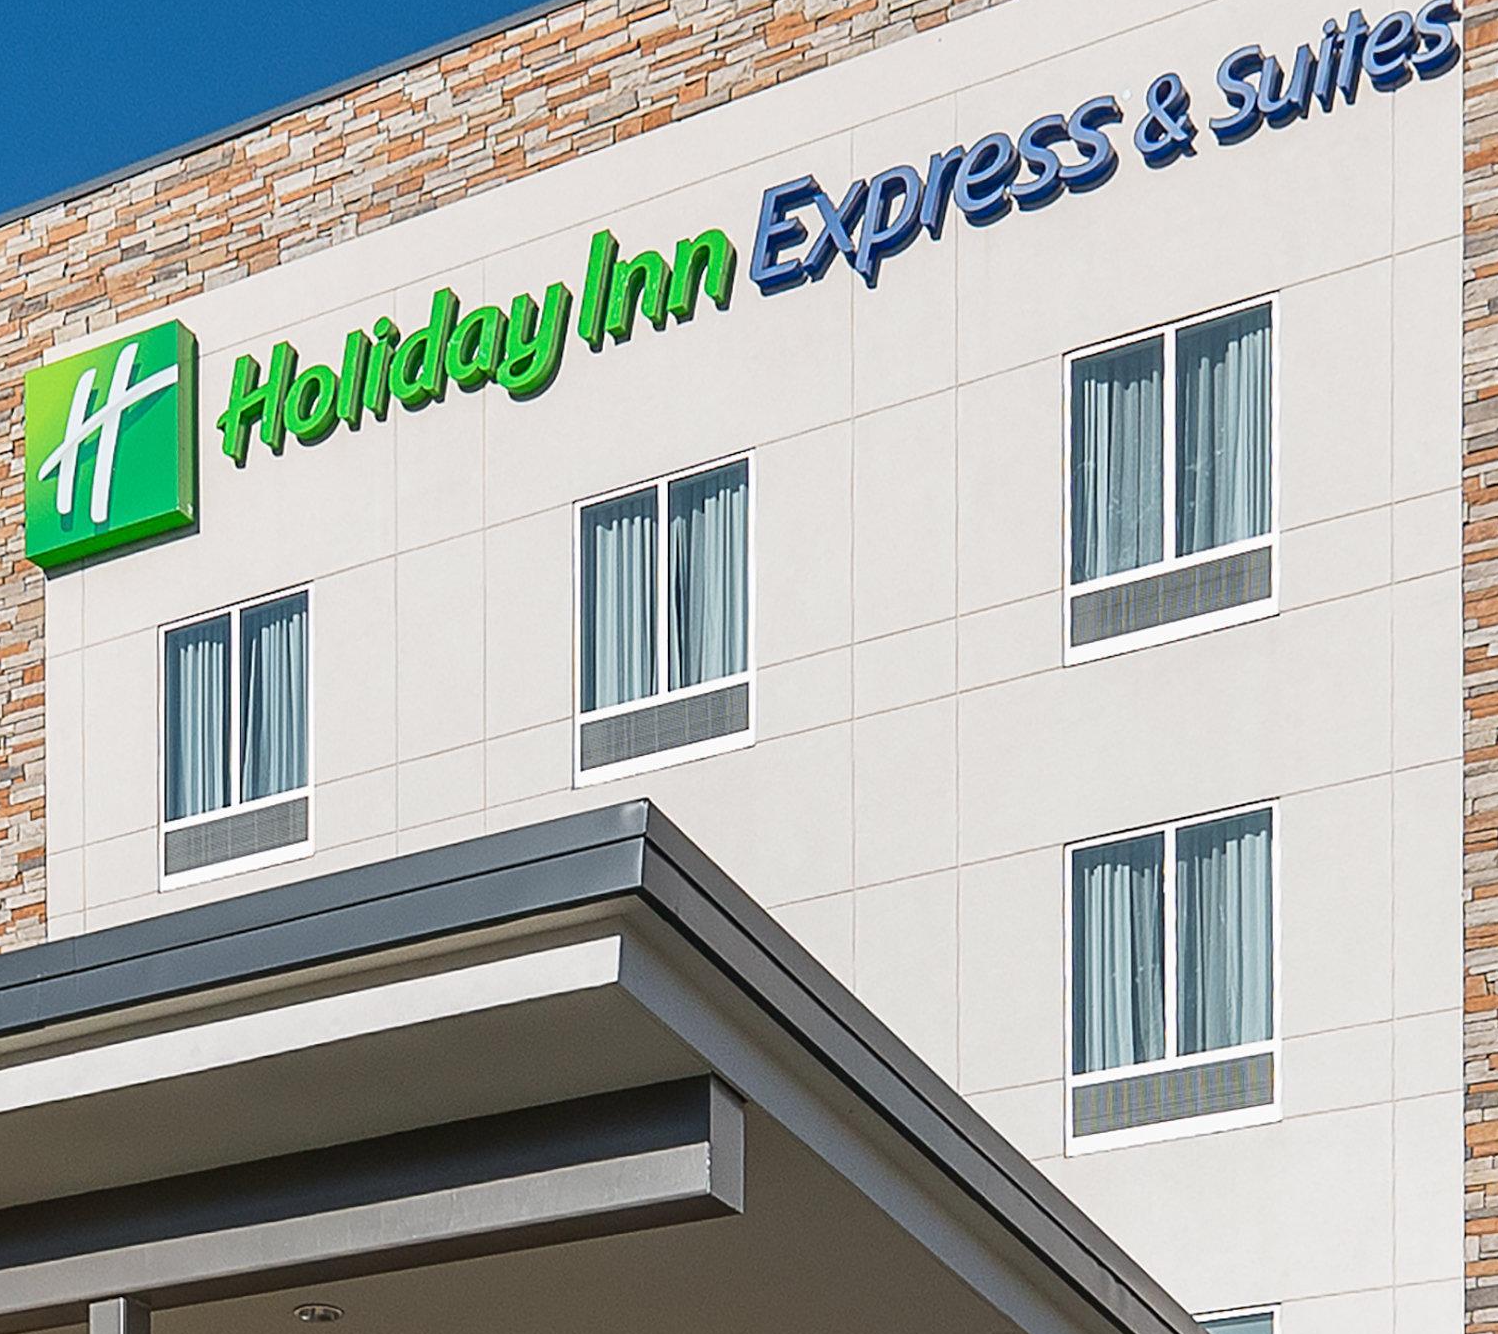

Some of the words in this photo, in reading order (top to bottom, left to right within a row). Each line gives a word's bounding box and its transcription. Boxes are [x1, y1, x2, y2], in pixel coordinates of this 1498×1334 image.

[217, 287, 572, 468] Holiday
[578, 229, 736, 352] Inn
[749, 95, 1123, 296] Express
[1134, 73, 1198, 169] &
